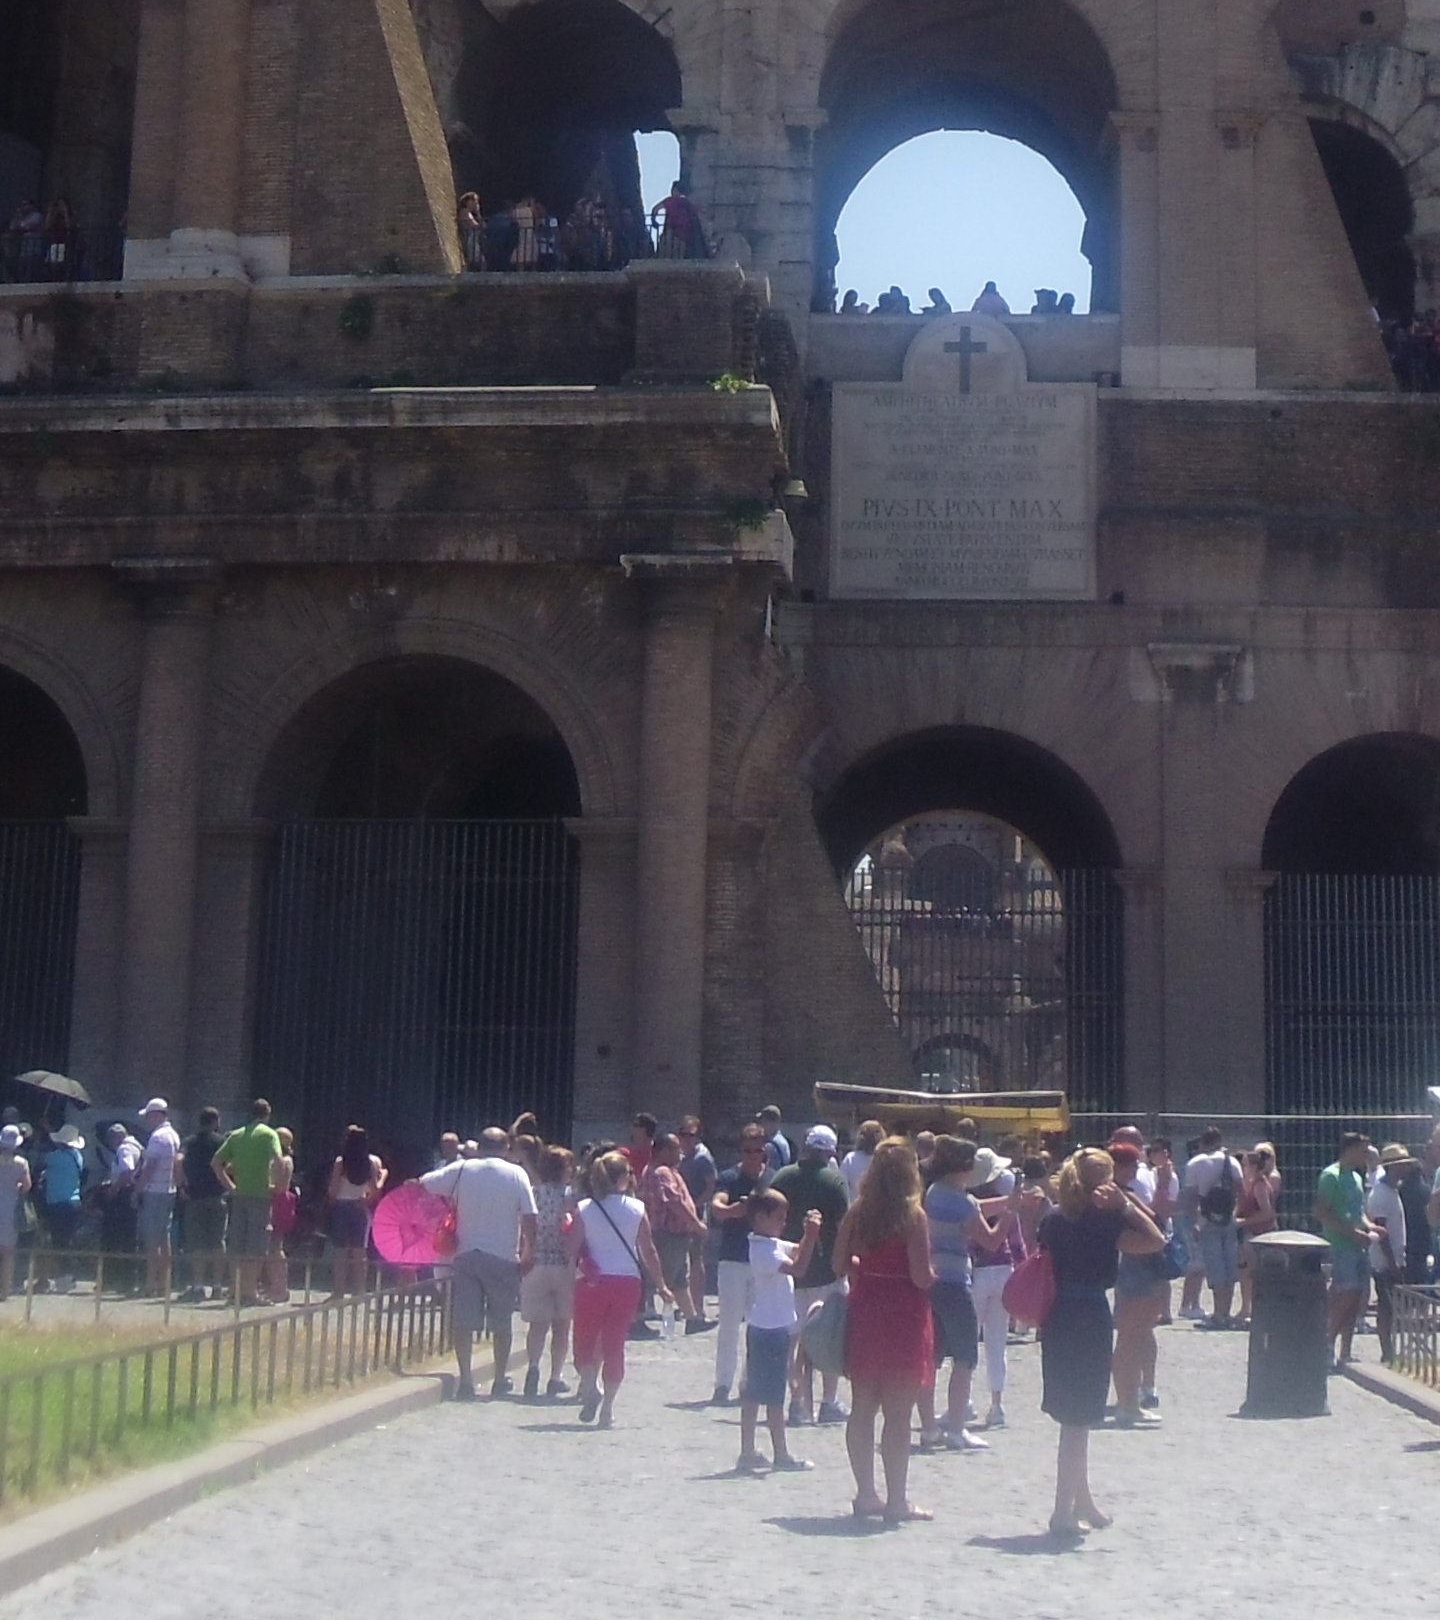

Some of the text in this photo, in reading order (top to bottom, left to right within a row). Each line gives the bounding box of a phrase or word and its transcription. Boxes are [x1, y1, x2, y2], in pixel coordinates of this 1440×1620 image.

[863, 498, 1062, 518] PIVS IX PONT MAX
